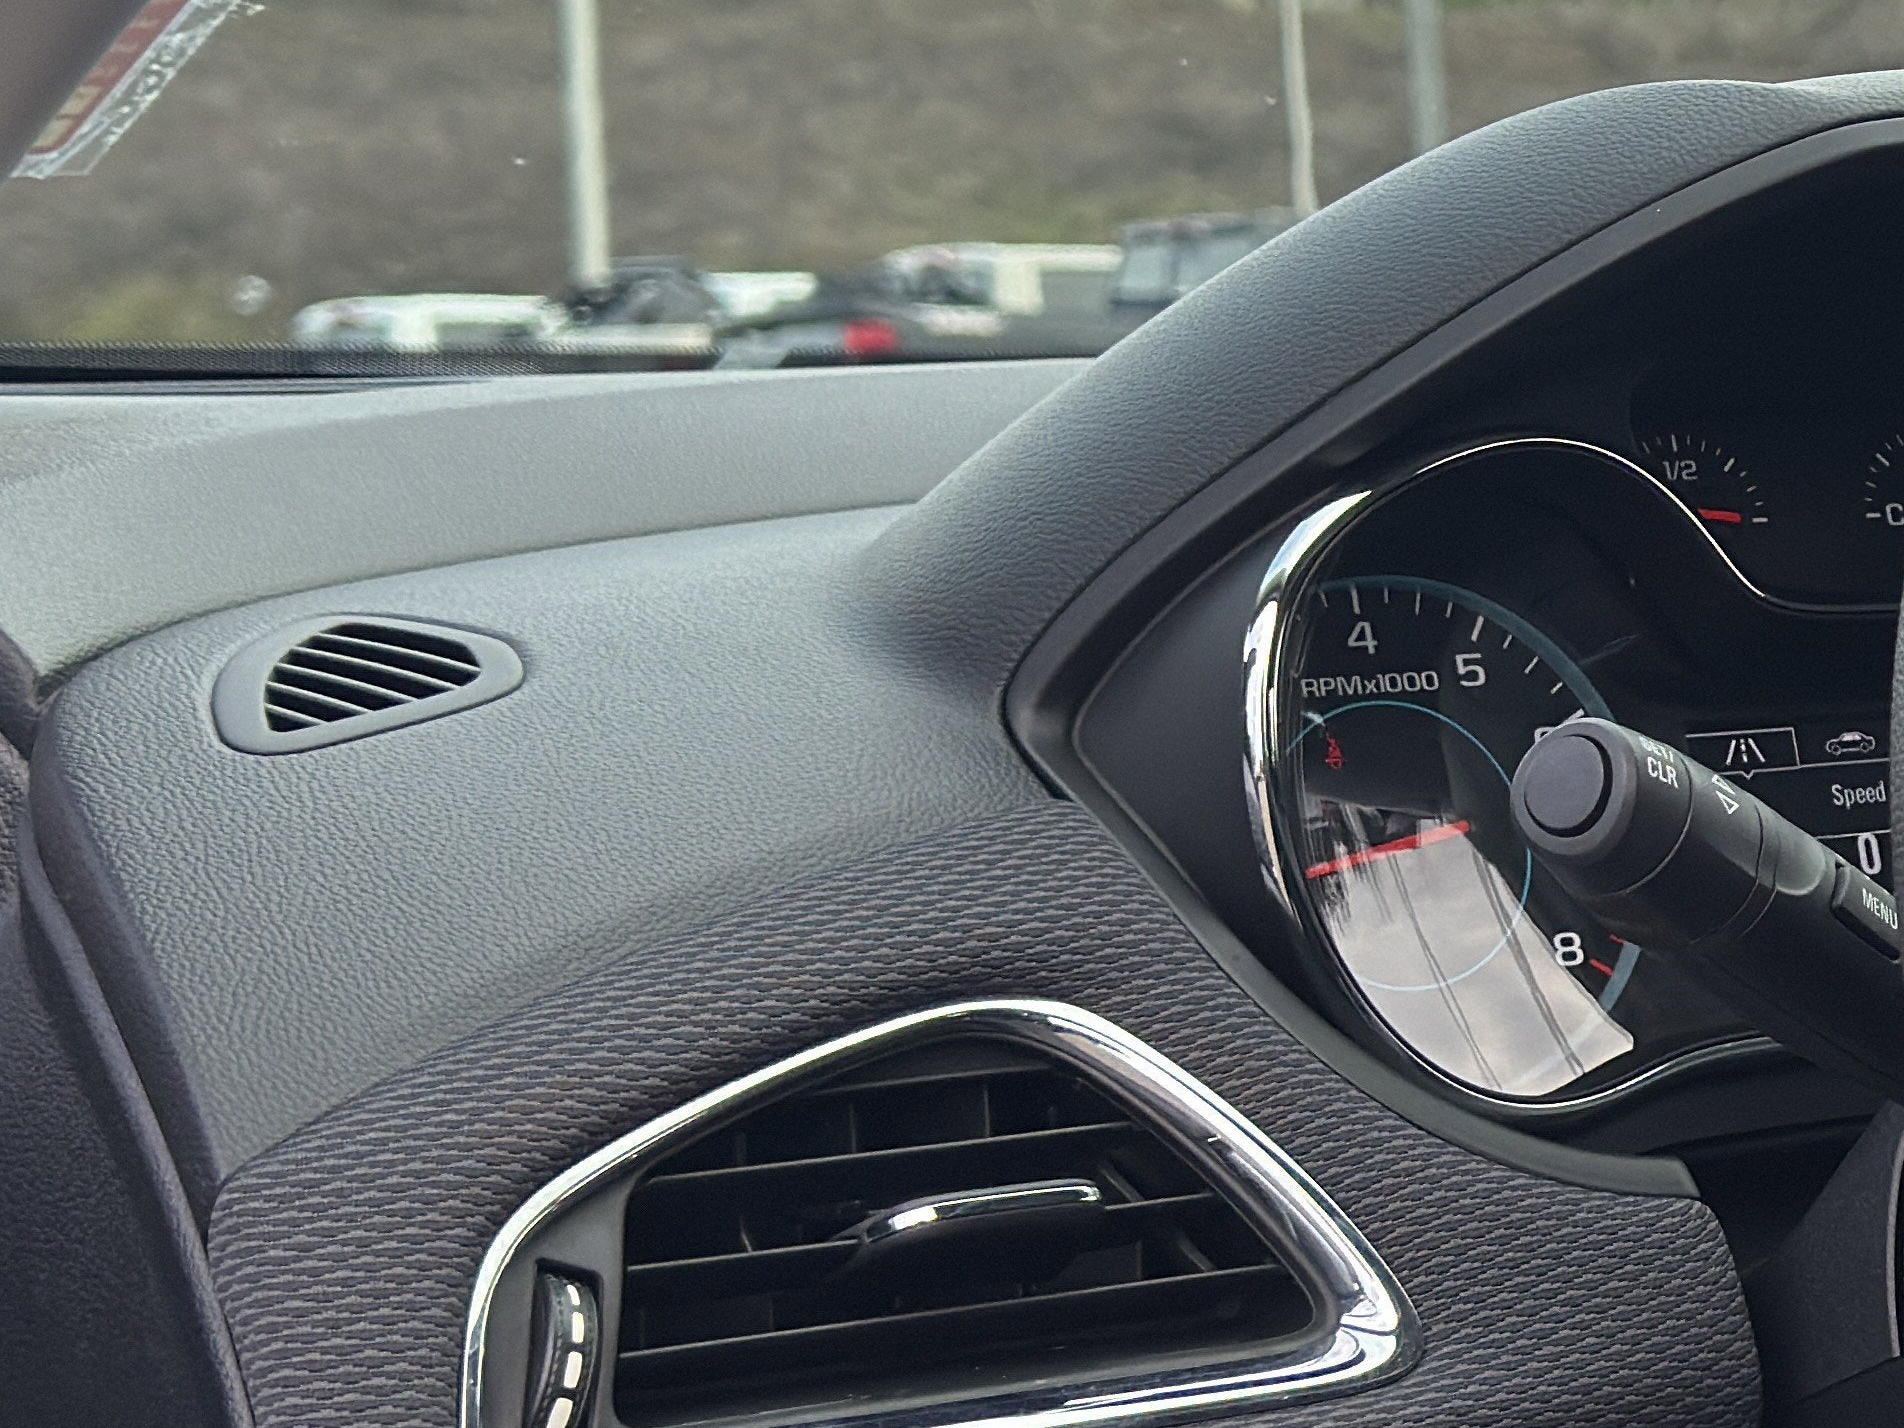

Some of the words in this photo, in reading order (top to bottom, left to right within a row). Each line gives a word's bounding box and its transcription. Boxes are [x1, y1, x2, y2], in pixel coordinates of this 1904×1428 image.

[1885, 503, 1904, 526] C
[1347, 621, 1378, 654] 4
[1301, 671, 1439, 698] RPMx1000
[1455, 652, 1486, 687] 5
[1647, 756, 1679, 789] CLR
[1832, 780, 1887, 810] Speed
[1857, 832, 1881, 874] 0
[1862, 887, 1899, 930] MENU
[1552, 931, 1584, 966] 8
